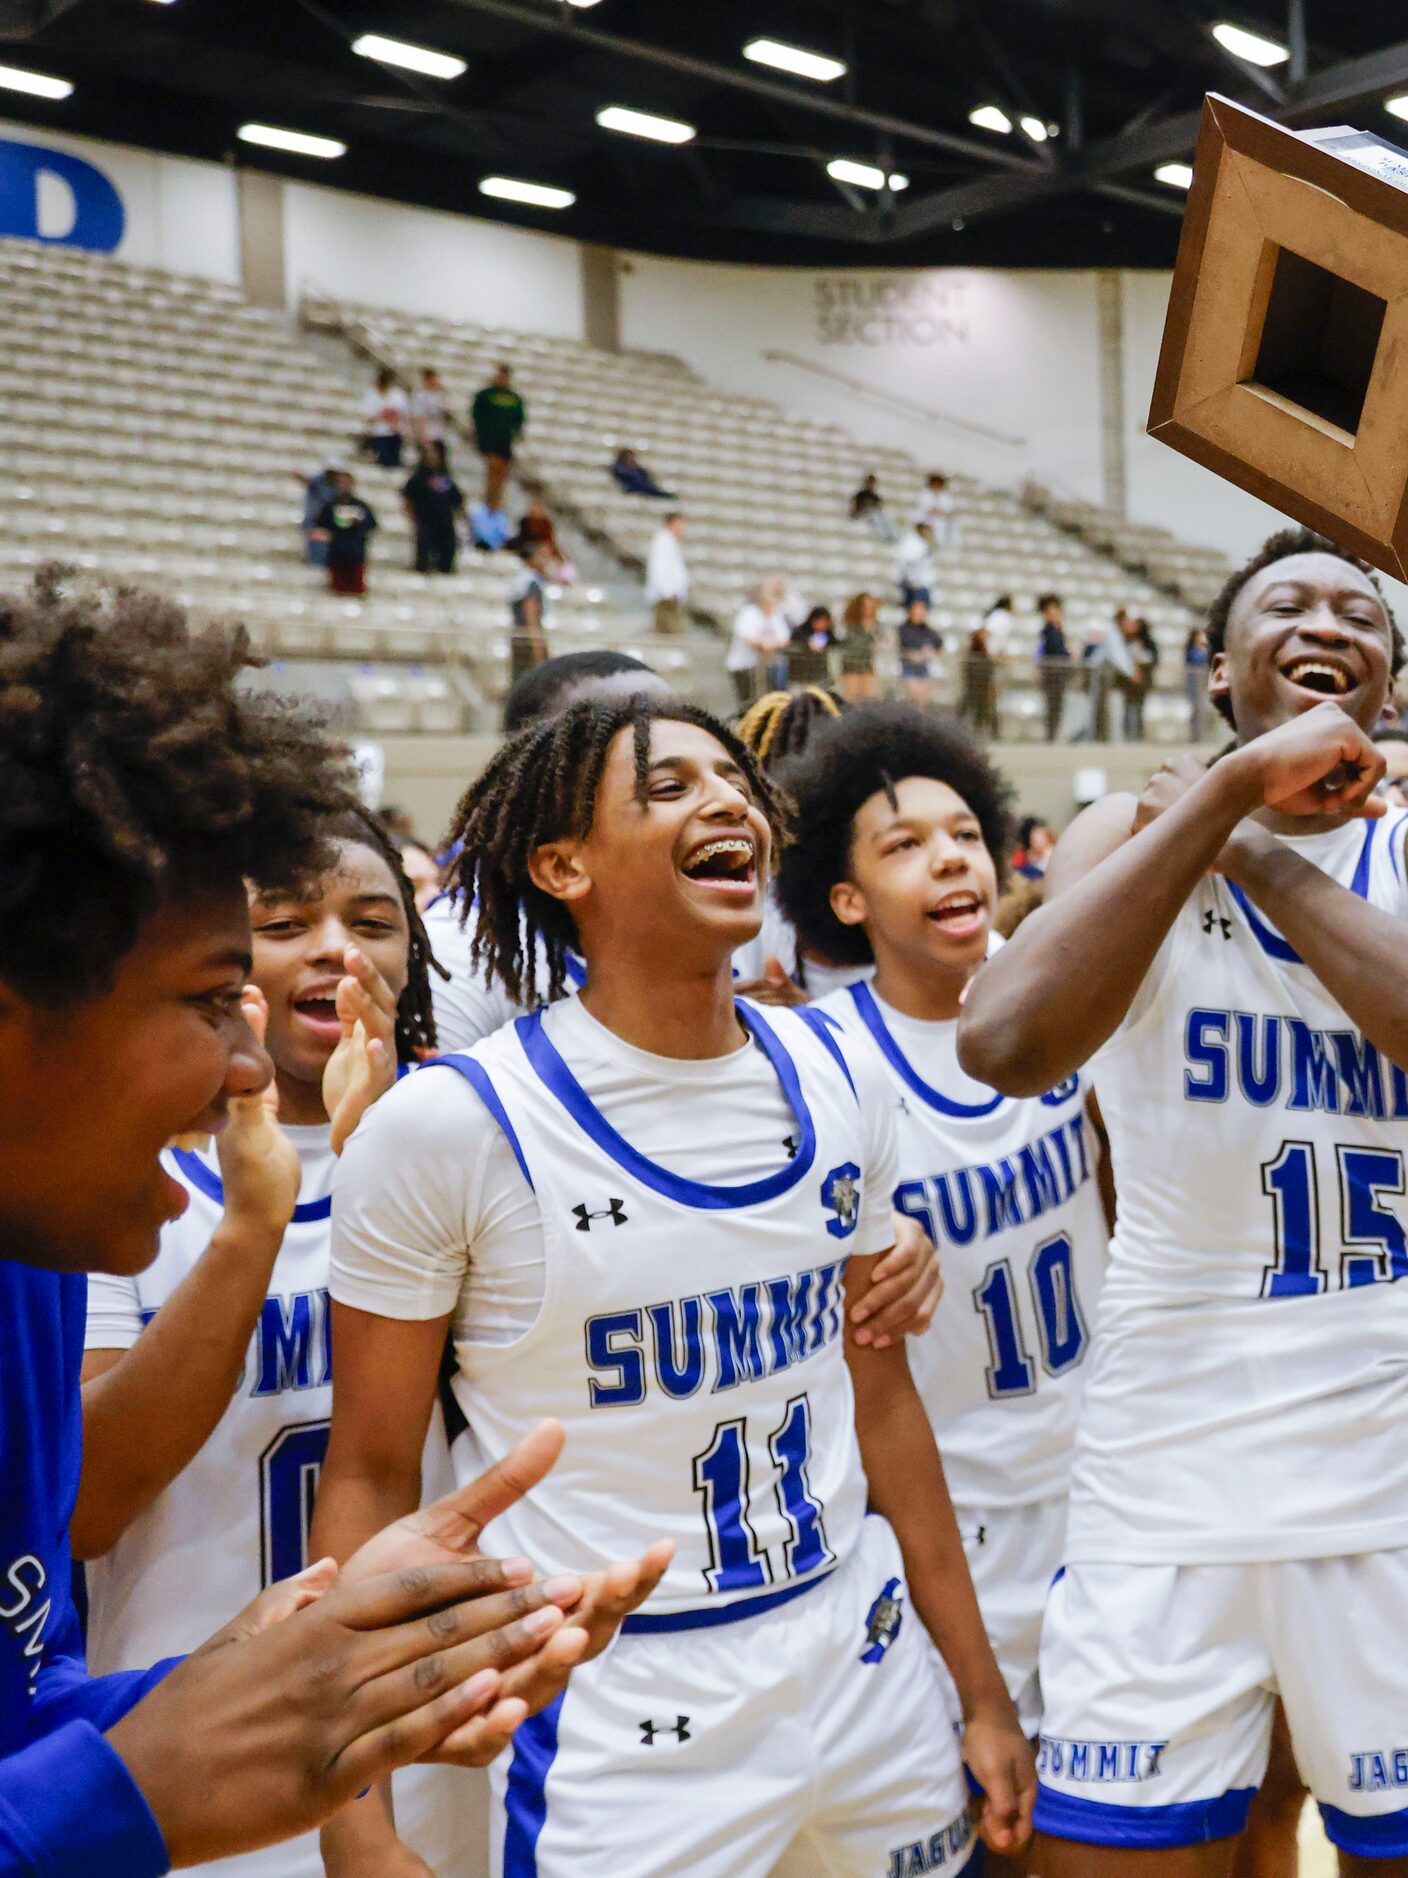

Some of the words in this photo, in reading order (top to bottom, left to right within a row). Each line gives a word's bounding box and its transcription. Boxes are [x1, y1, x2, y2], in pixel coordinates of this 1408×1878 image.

[814, 276, 968, 311] STUDENT
[816, 315, 969, 346] SECTION
[972, 1230, 1090, 1400] 10
[692, 1392, 837, 1593] 11
